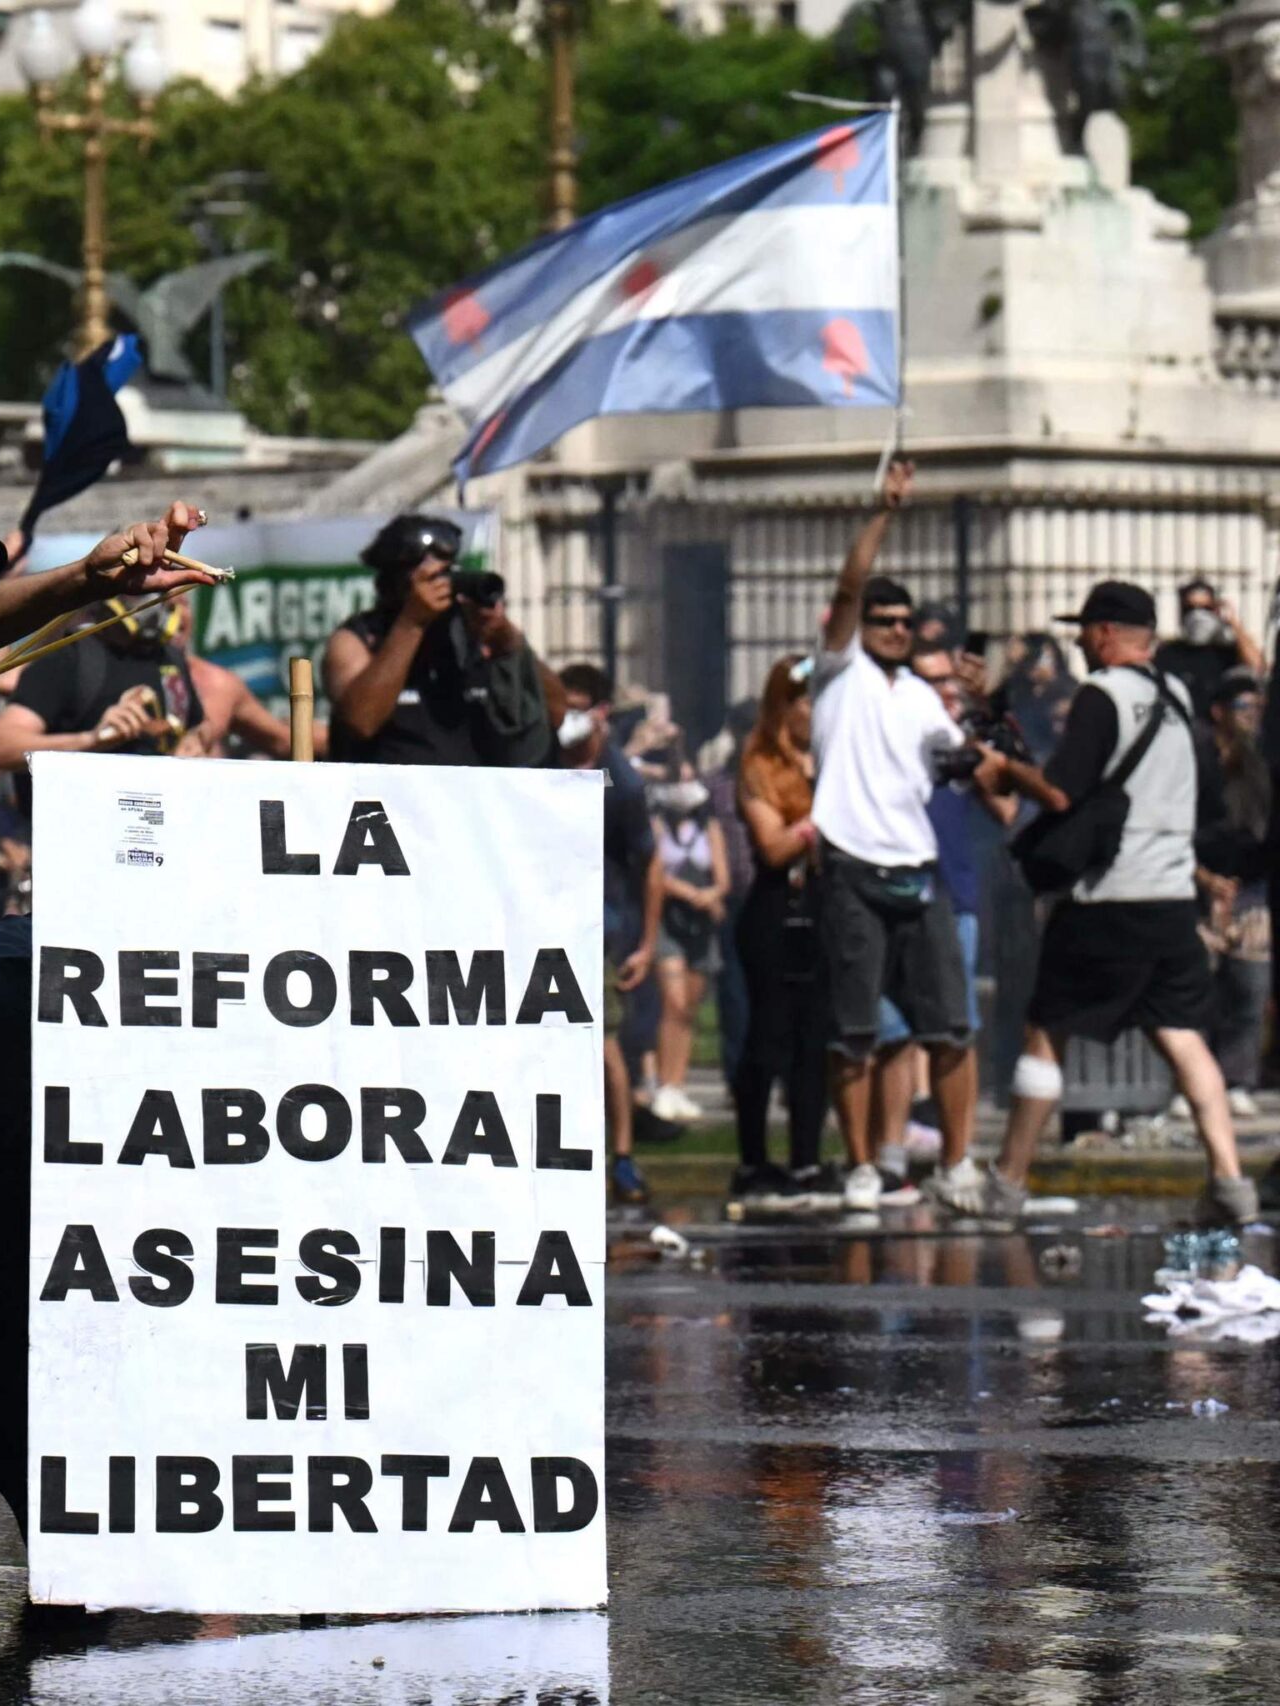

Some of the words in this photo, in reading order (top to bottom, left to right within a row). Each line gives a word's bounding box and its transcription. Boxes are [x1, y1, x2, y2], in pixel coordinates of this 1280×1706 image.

[260, 800, 411, 876] LA
[37, 946, 593, 1028] REFORMA
[43, 1083, 593, 1171] LABORAL
[39, 1224, 593, 1308] ASESINA
[245, 1343, 370, 1421] MI
[39, 1454, 599, 1535] LIBERTAD
